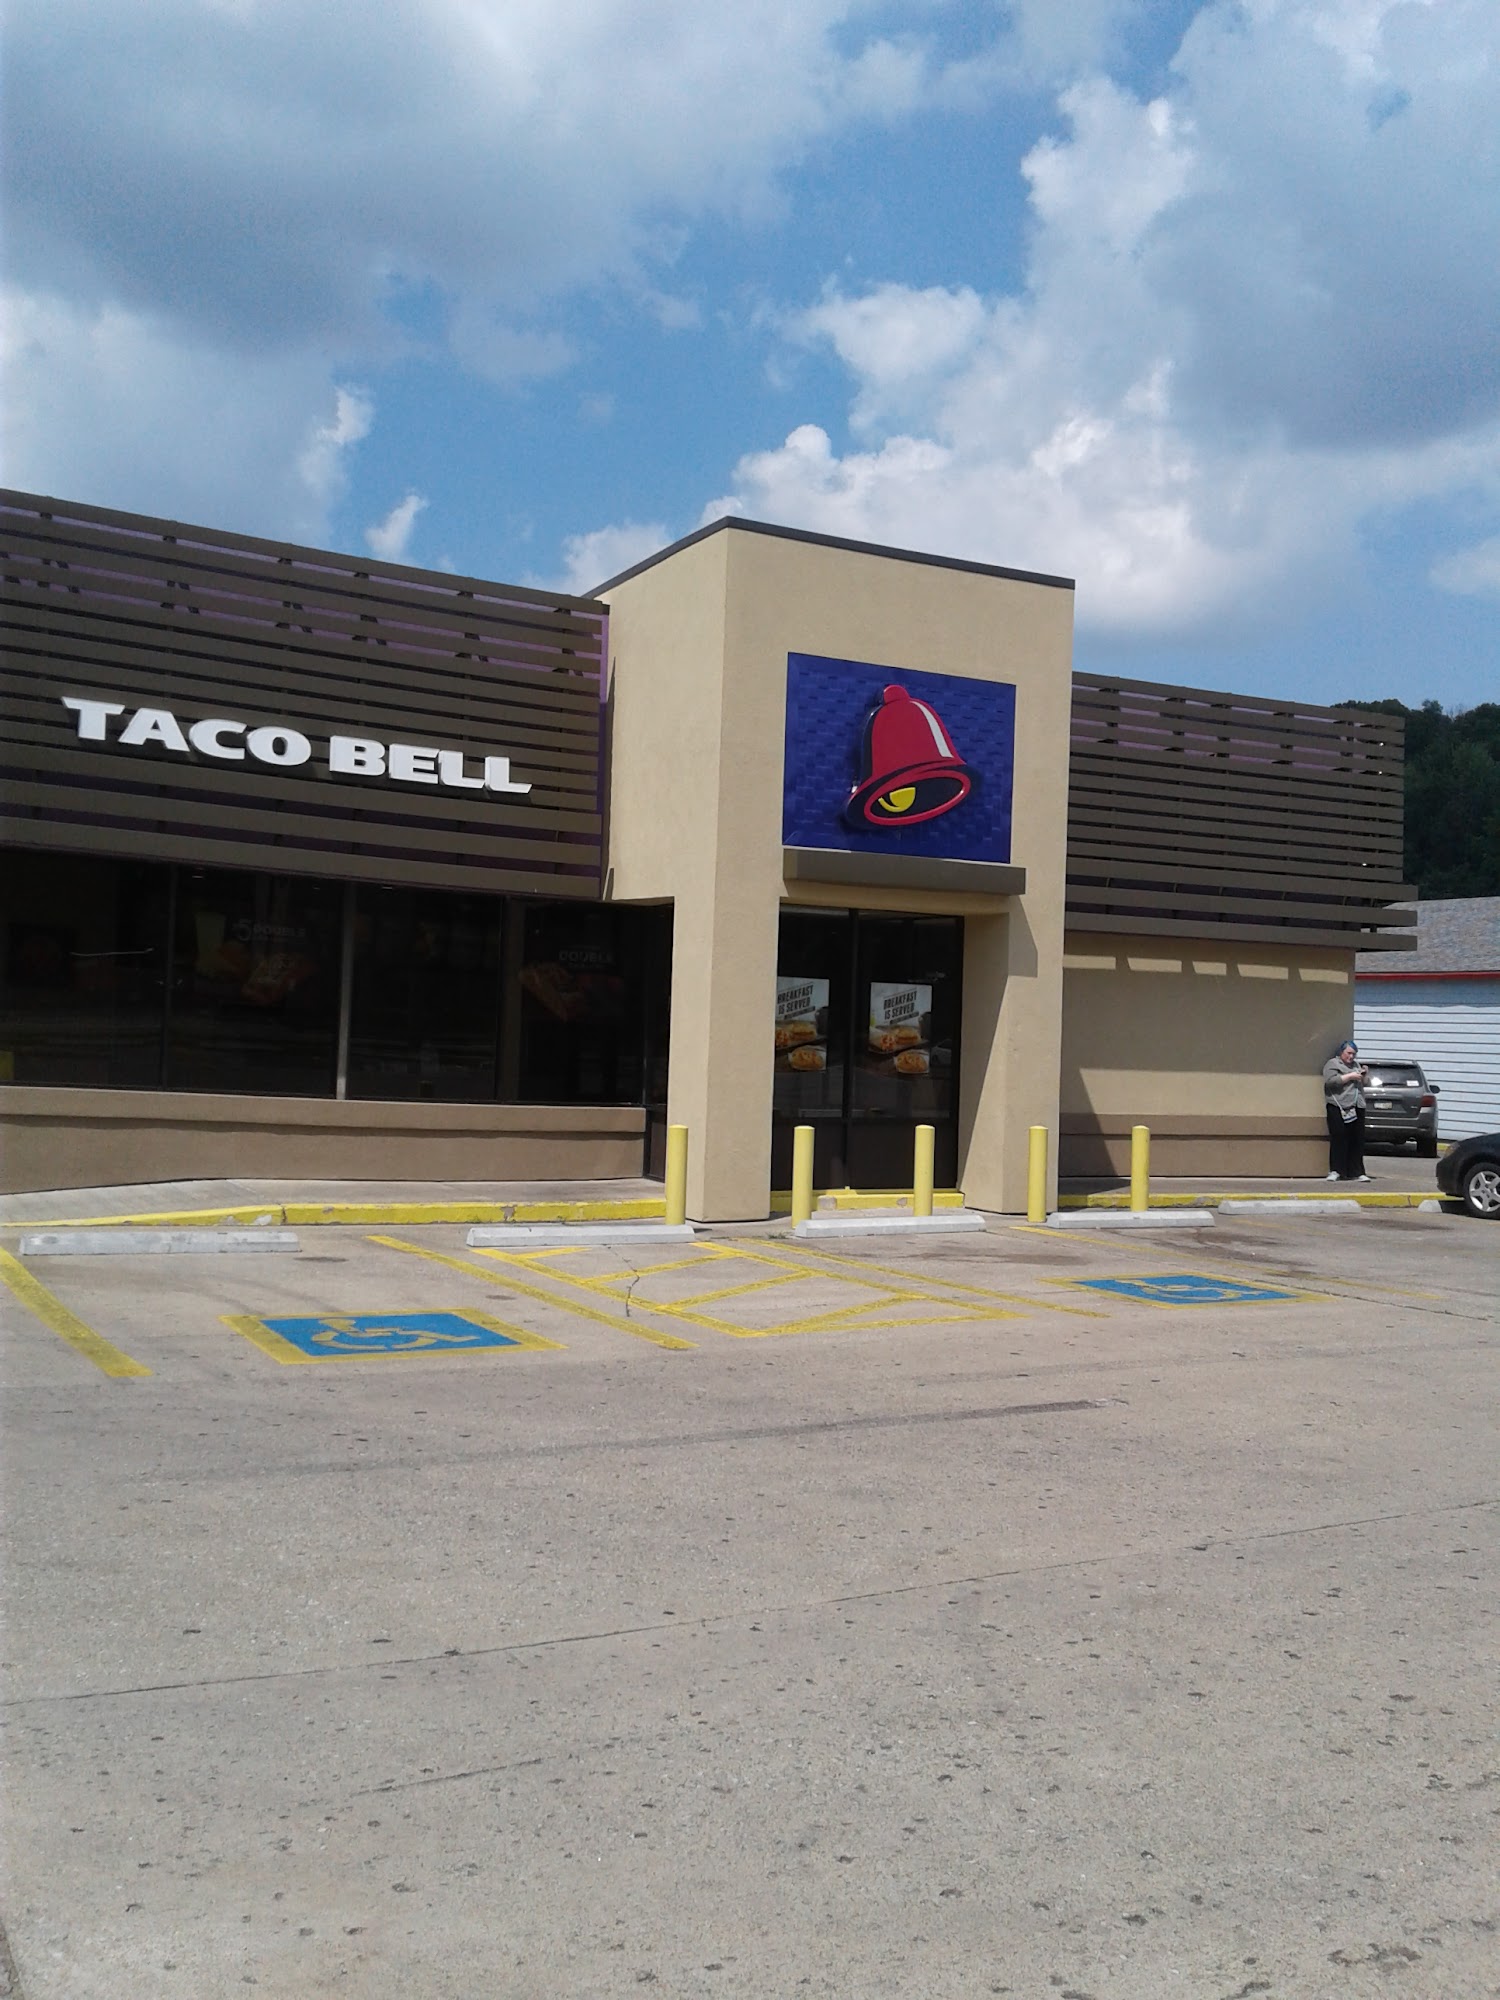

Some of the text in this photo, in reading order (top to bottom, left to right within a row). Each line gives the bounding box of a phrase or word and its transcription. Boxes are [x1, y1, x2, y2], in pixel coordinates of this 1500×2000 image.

[61, 696, 532, 794] TACO BELL
[777, 984, 814, 1004] BREAKFAST
[883, 990, 917, 1010] BREAKFAST
[778, 1003, 785, 1015] IS
[786, 996, 811, 1013] SERVED
[884, 1009, 891, 1020] IS
[891, 1002, 915, 1018] SERVED
